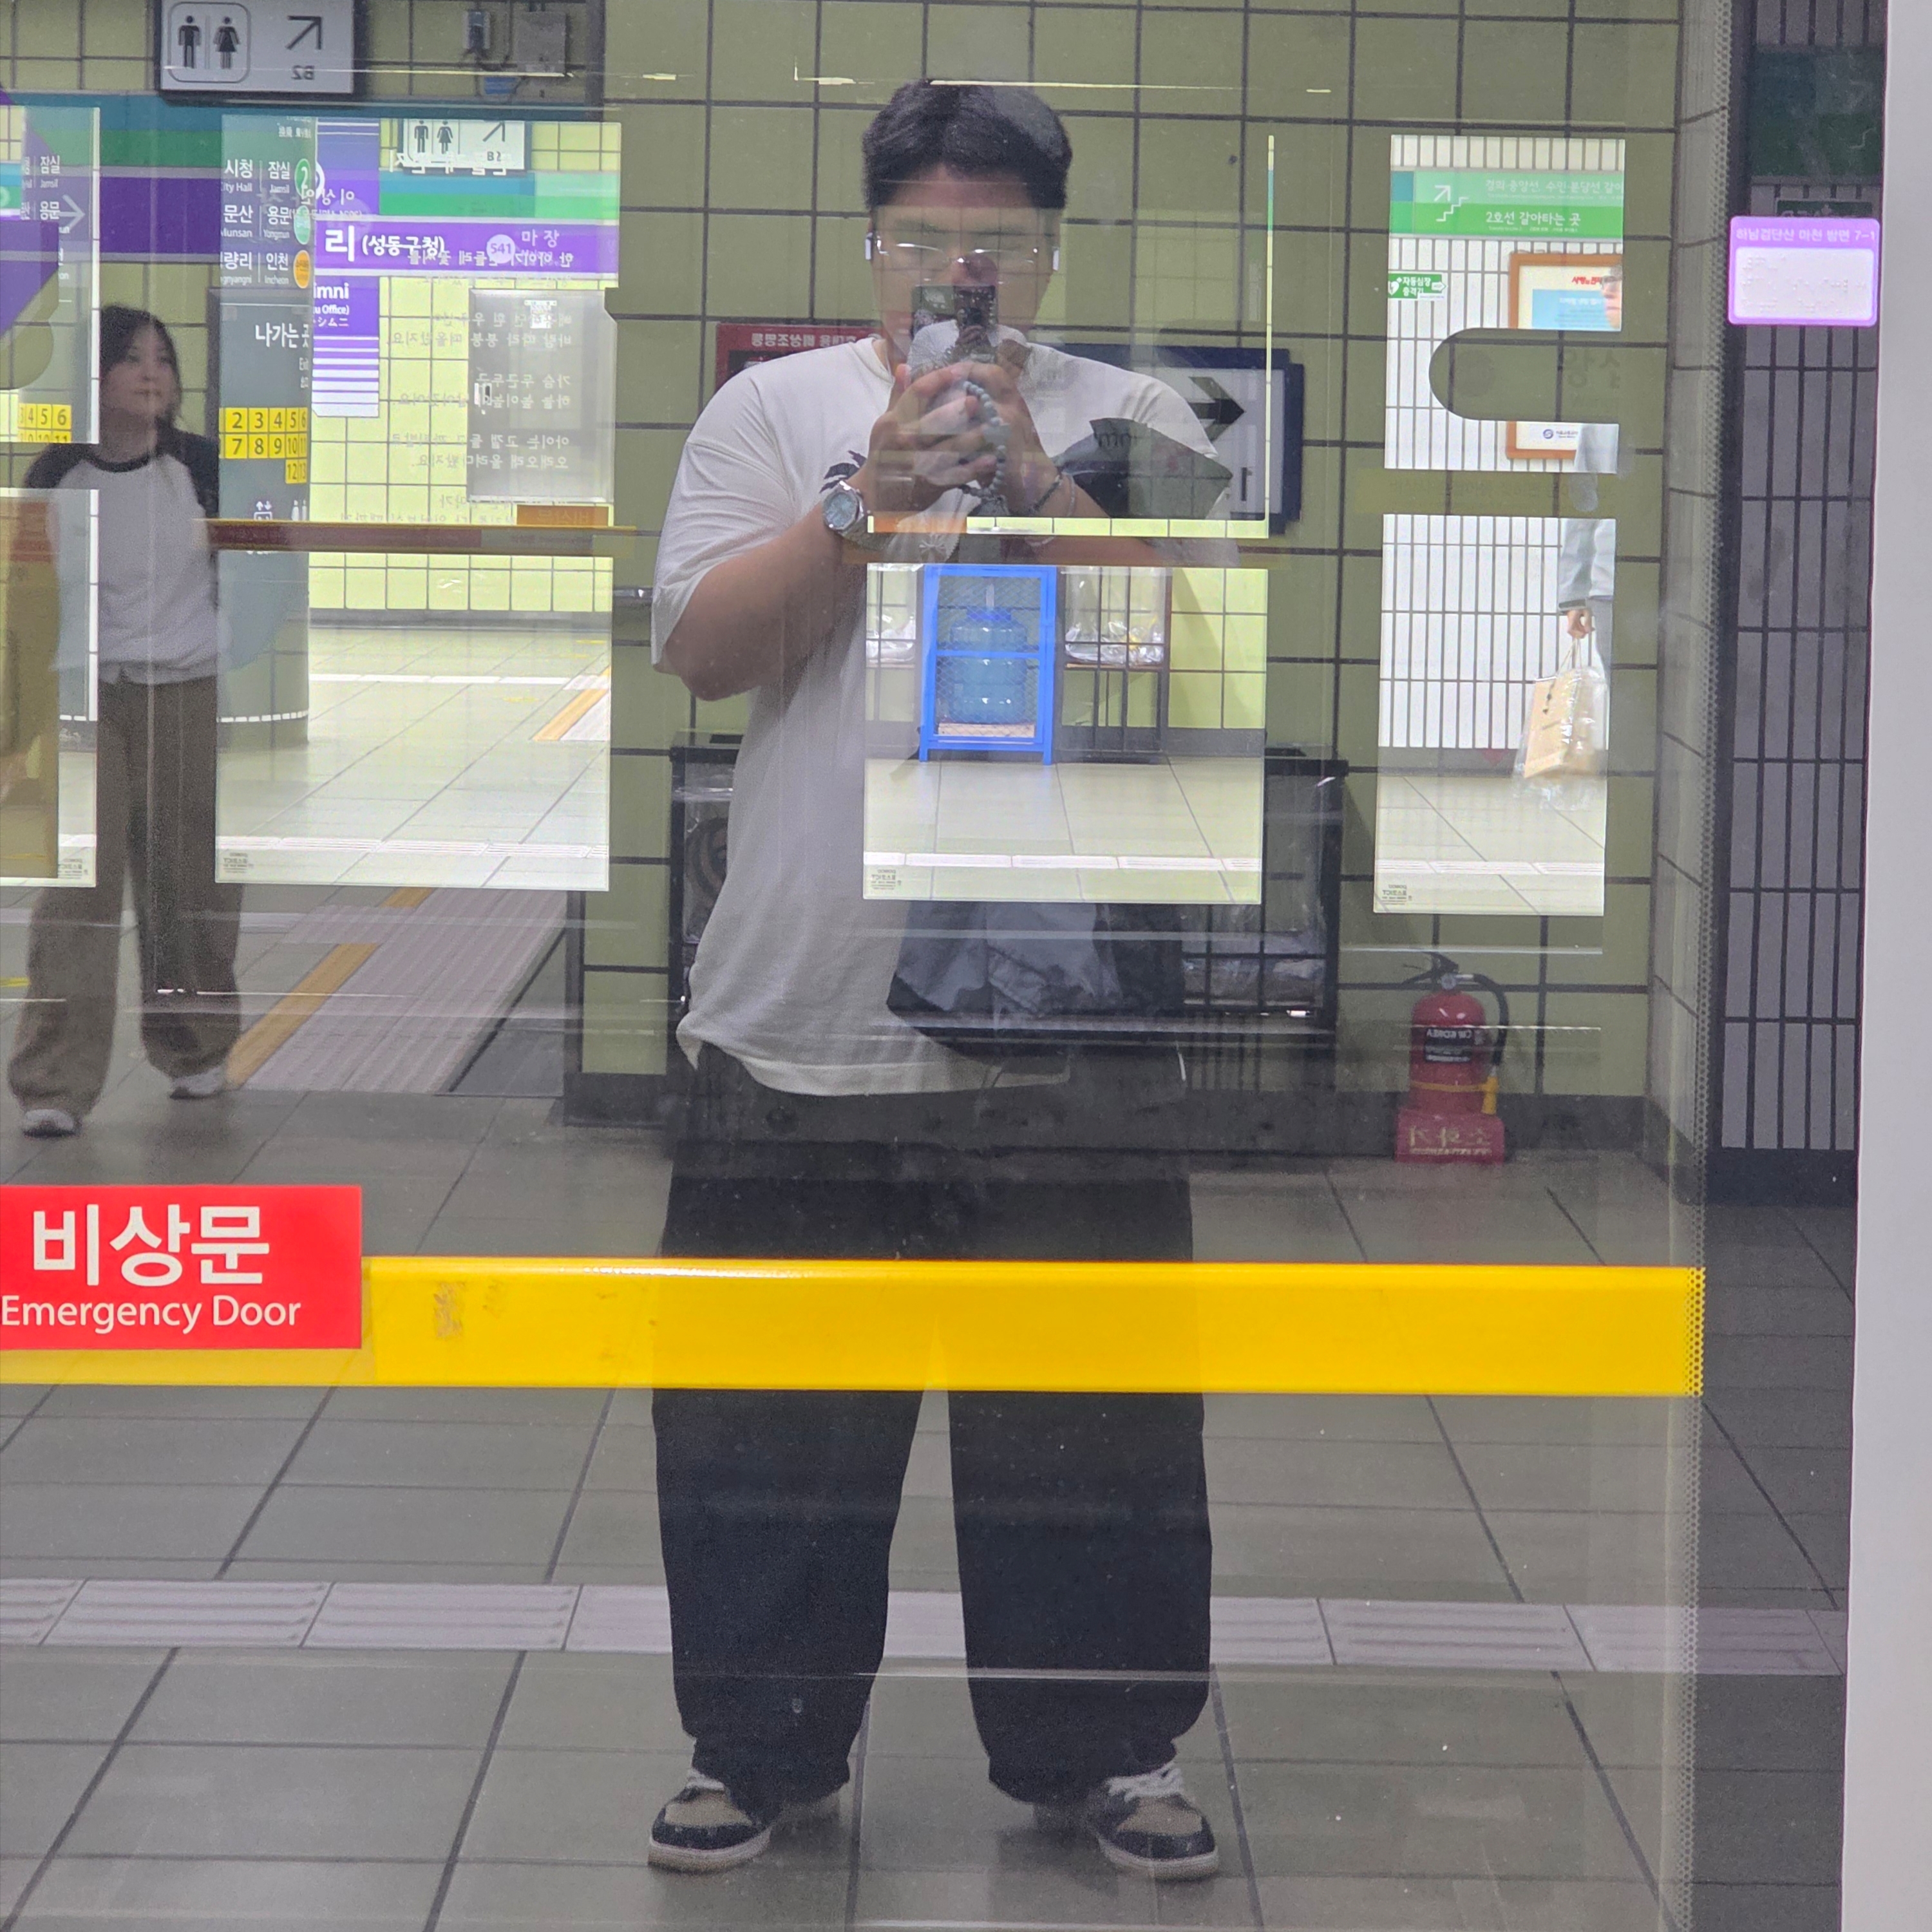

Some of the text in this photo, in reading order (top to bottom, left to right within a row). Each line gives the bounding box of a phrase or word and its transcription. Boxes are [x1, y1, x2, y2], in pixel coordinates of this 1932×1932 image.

[41, 155, 61, 174] 잠실
[224, 159, 253, 178] 시청
[268, 161, 290, 180] 잠실
[236, 182, 252, 192] Hall
[40, 201, 60, 220] 용문
[223, 205, 254, 223] 문산
[267, 206, 290, 225] 용문
[1486, 211, 1581, 226] 2호선 갈아타는 곳
[325, 225, 444, 262] 리 (성동구청)
[1799, 229, 1823, 242] 마천
[1855, 231, 1875, 242] 7-1
[491, 243, 511, 254] 541
[266, 252, 289, 270] 인천
[1403, 277, 1431, 287] 자동심장
[322, 304, 350, 315] Office)
[313, 316, 349, 327] シムニ
[256, 322, 309, 348] 나가는 곳
[41, 408, 48, 425] 5
[57, 408, 67, 426] 6
[232, 411, 306, 429] 2 3 4 5 6
[232, 437, 306, 455] 7 8 9 10 11
[287, 463, 306, 480] 12 13
[33, 1203, 270, 1287] 비상문
[1, 1294, 301, 1335] Emergency Door
